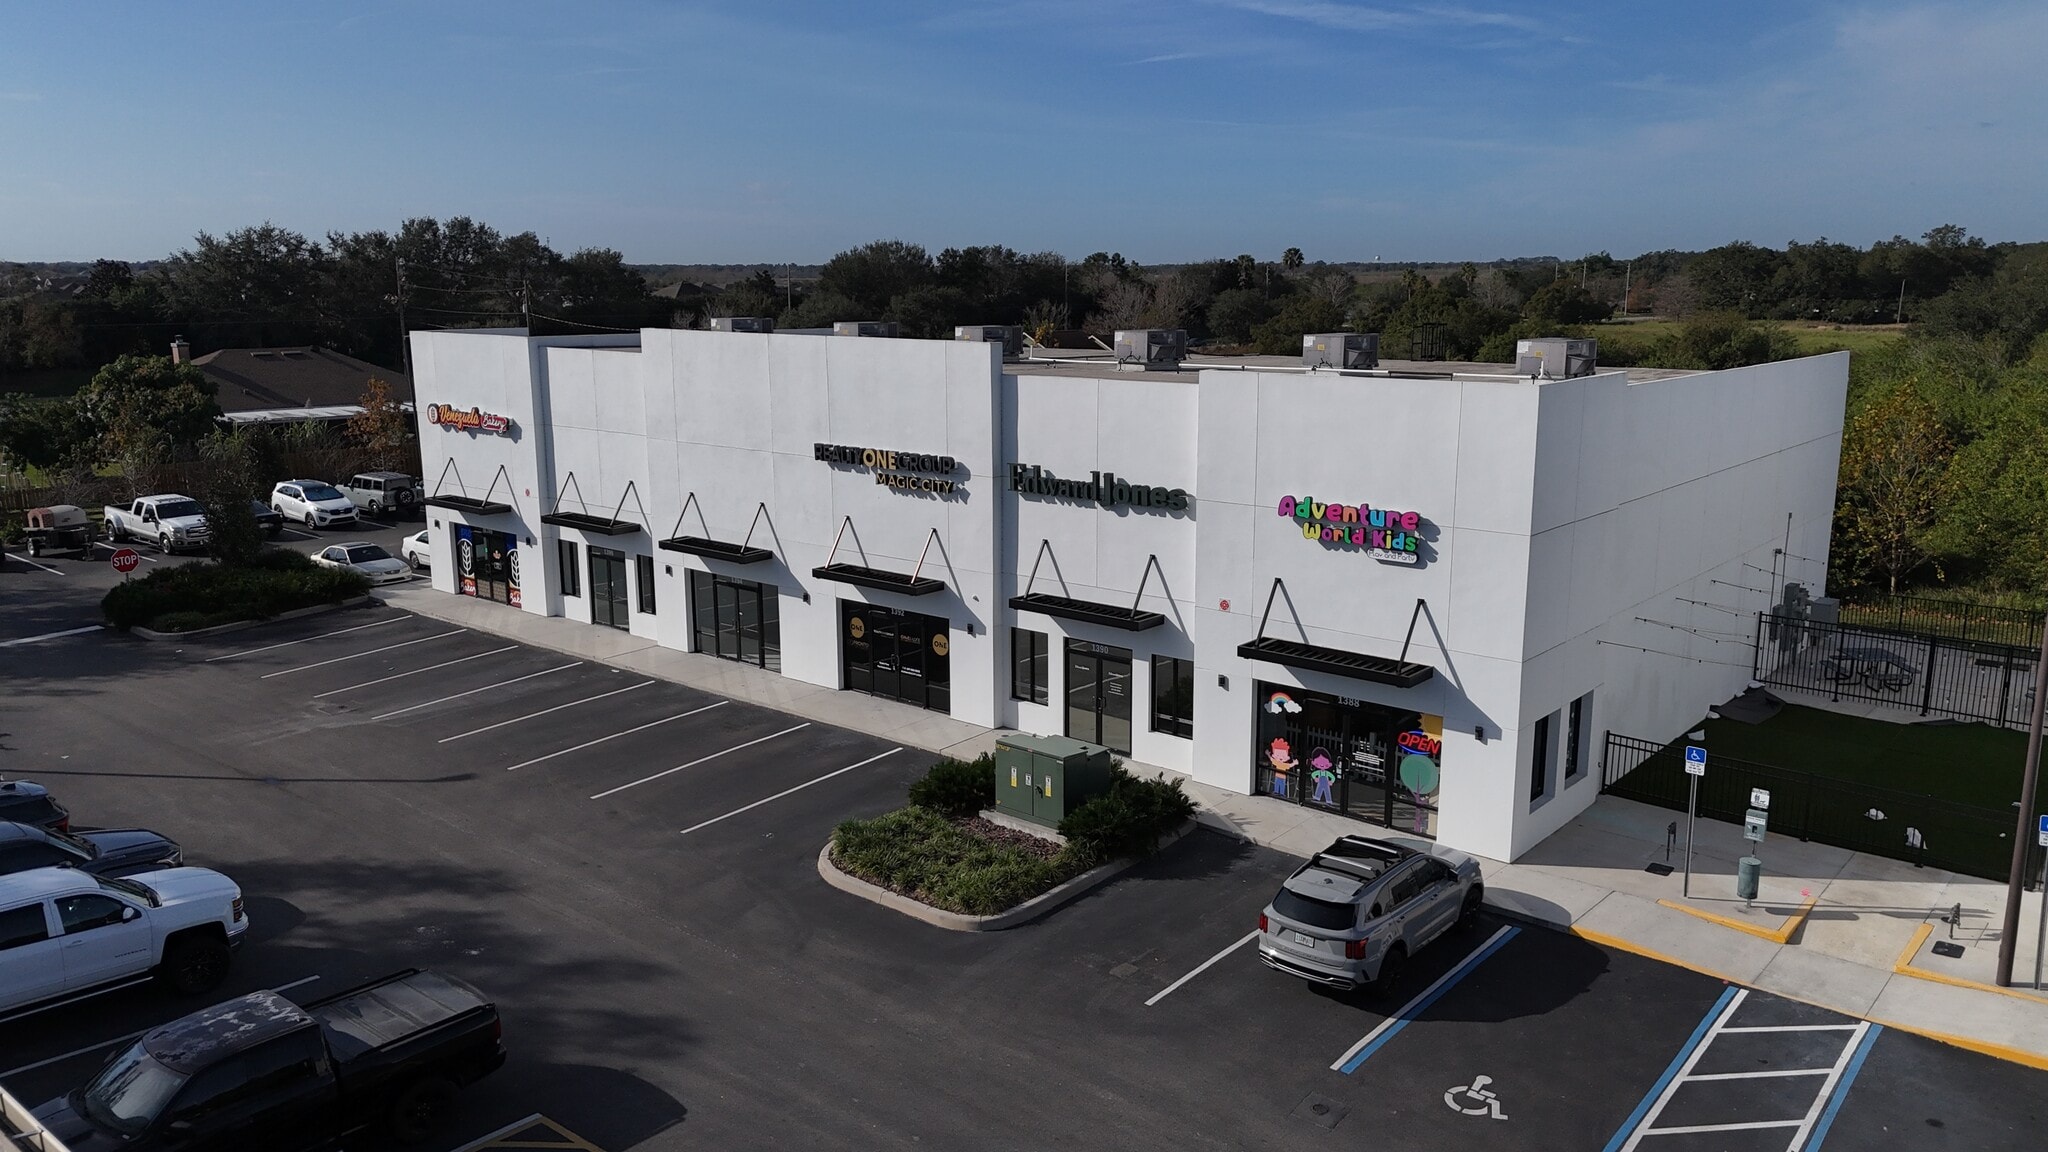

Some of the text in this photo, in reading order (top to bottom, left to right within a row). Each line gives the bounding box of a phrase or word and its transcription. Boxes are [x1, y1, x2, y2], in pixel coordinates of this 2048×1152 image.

[439, 405, 480, 429] Venezuela
[876, 473, 952, 495] MAGIC CITY
[1008, 463, 1189, 511] Edward Jones
[1278, 495, 1419, 531] Adventure
[1302, 522, 1418, 551] World Kids
[113, 555, 137, 567] STOP
[850, 623, 864, 632] ONE
[933, 641, 947, 649] ONE
[1091, 643, 1109, 654] 1390
[1337, 695, 1361, 708] 1388
[1397, 731, 1441, 754] OPEN
